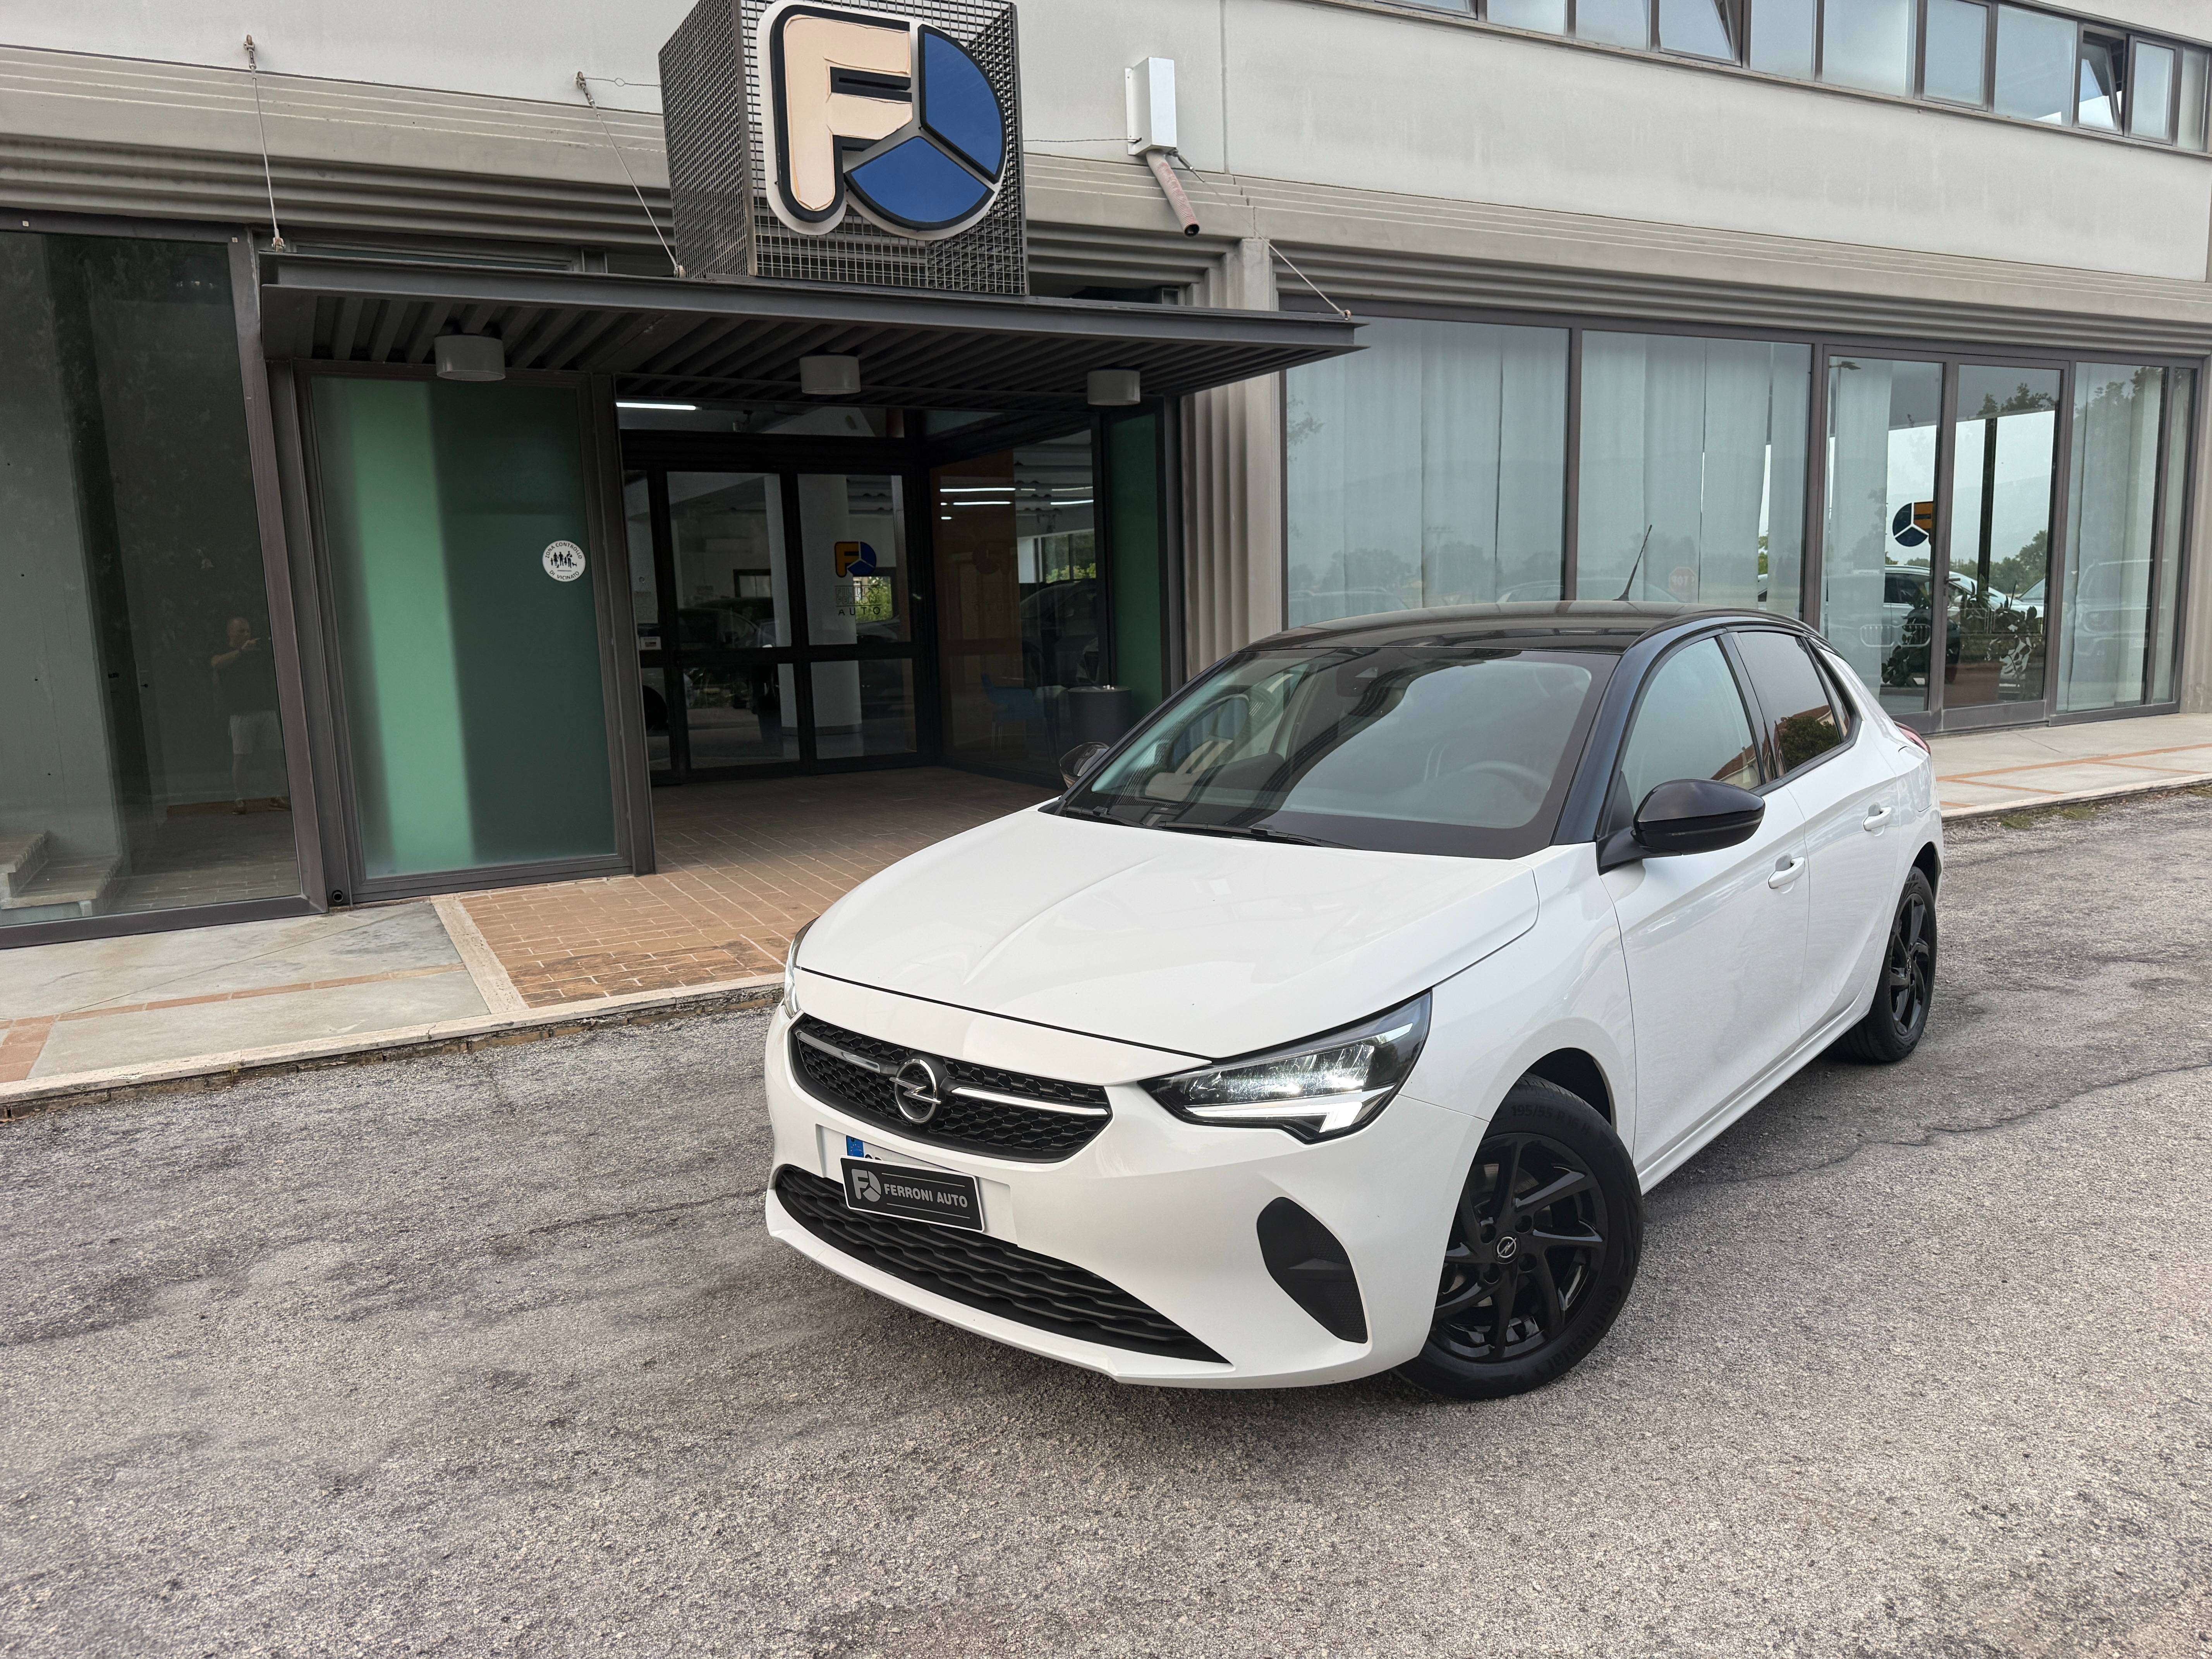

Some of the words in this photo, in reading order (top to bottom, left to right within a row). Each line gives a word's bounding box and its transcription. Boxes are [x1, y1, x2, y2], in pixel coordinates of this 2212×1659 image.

[545, 545, 555, 559] ZONA
[555, 542, 582, 559] CONTROLLO
[557, 571, 579, 580] VICINATO
[838, 606, 881, 616] AUTO
[1510, 1104, 1554, 1119] 195/55
[1556, 1109, 1566, 1121] R
[884, 1183, 933, 1202] FERRONI
[937, 1192, 968, 1208] AUTO
[1546, 1285, 1622, 1371] Continental
